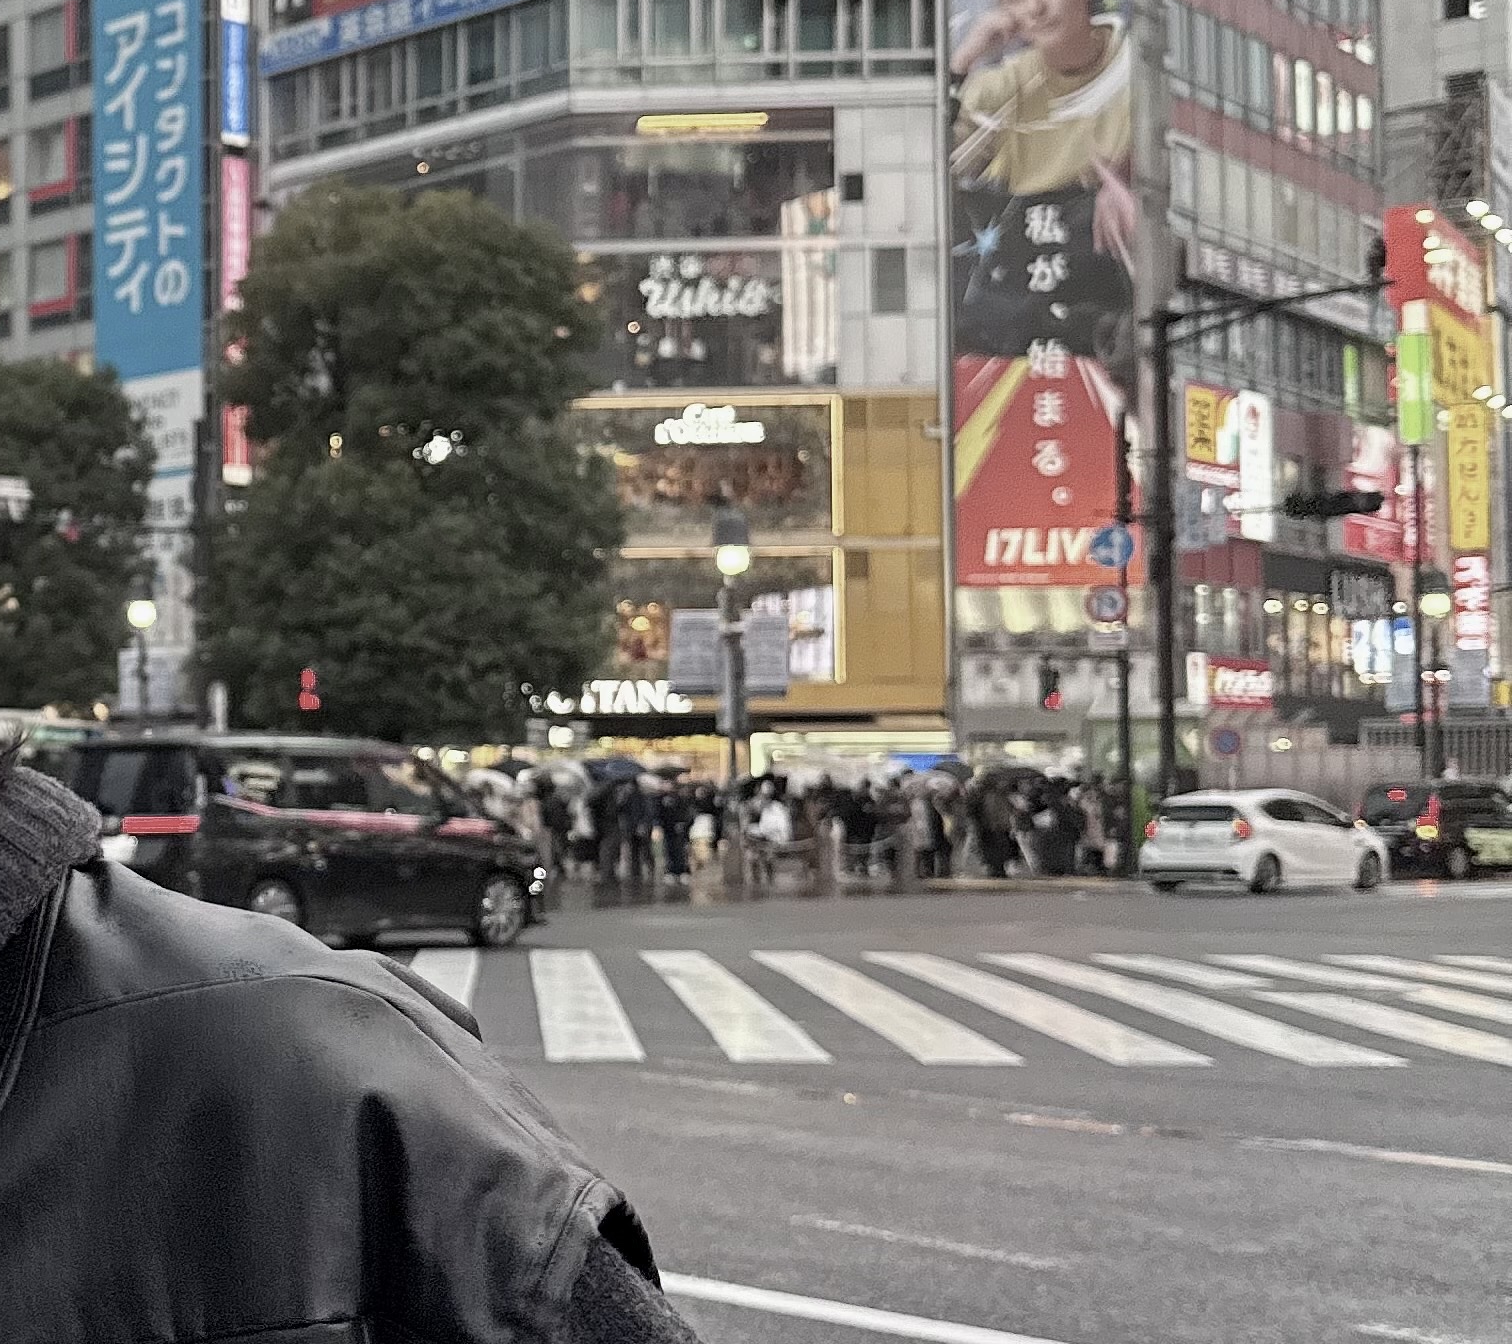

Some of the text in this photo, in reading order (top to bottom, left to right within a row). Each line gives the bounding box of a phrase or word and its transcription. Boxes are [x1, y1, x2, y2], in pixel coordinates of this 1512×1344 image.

[103, 11, 150, 314] アイシティ
[154, 0, 189, 306] コンタクトの
[984, 526, 1096, 567] 17LIV
